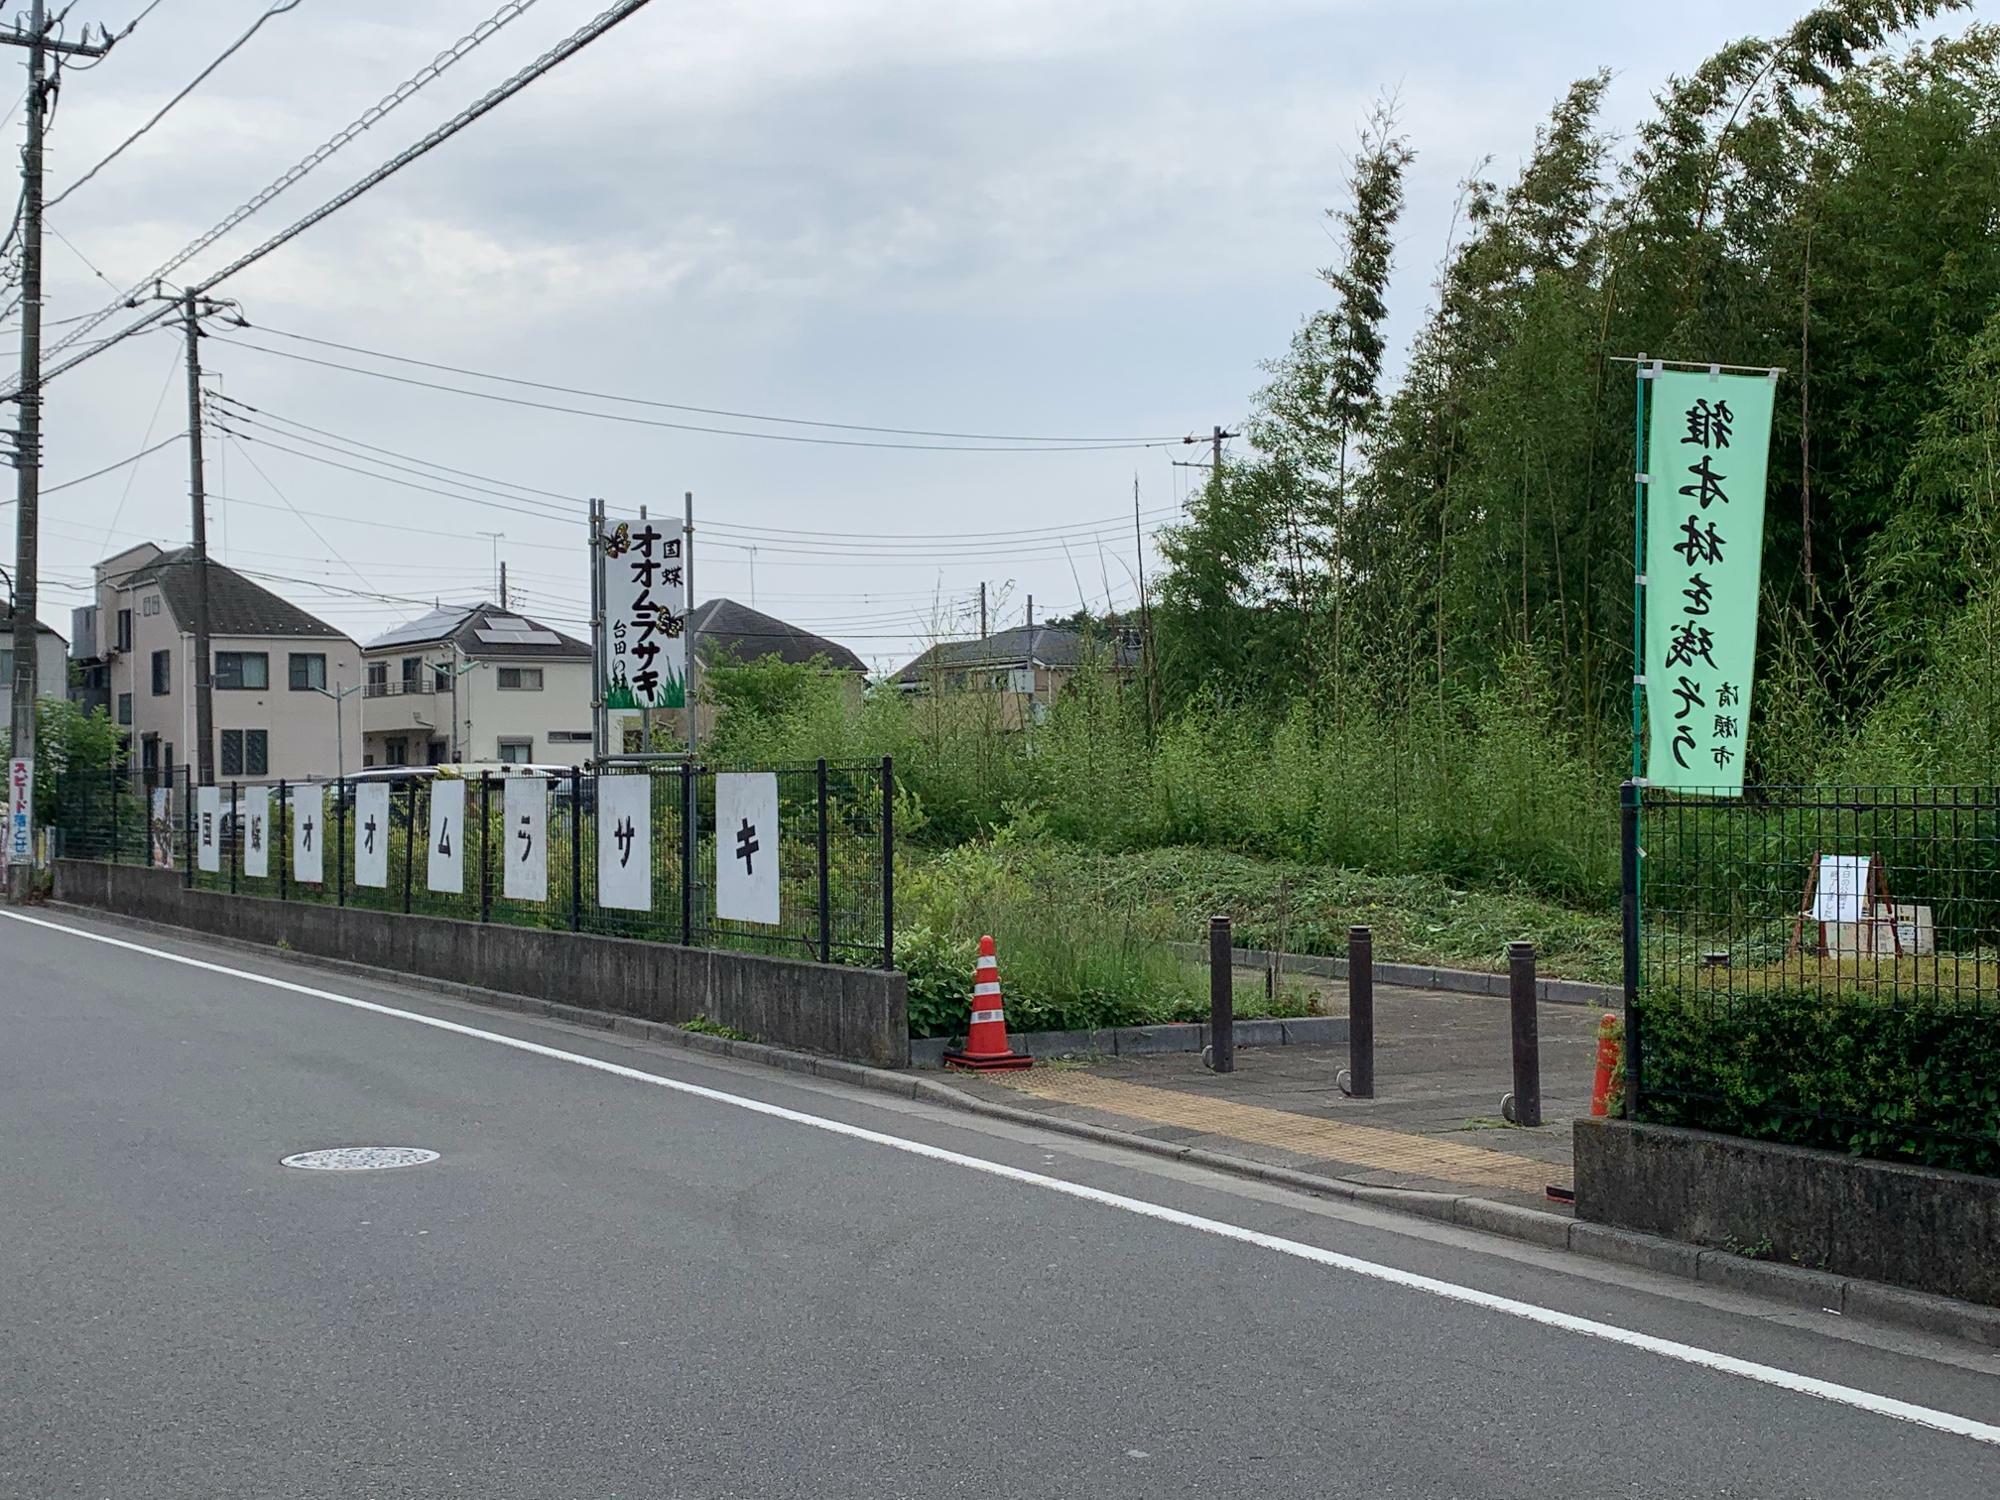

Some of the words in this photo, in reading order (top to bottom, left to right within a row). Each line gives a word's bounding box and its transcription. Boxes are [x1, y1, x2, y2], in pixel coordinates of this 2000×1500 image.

[630, 524, 662, 702] オオムラサキ
[661, 538, 684, 588] 国蝶
